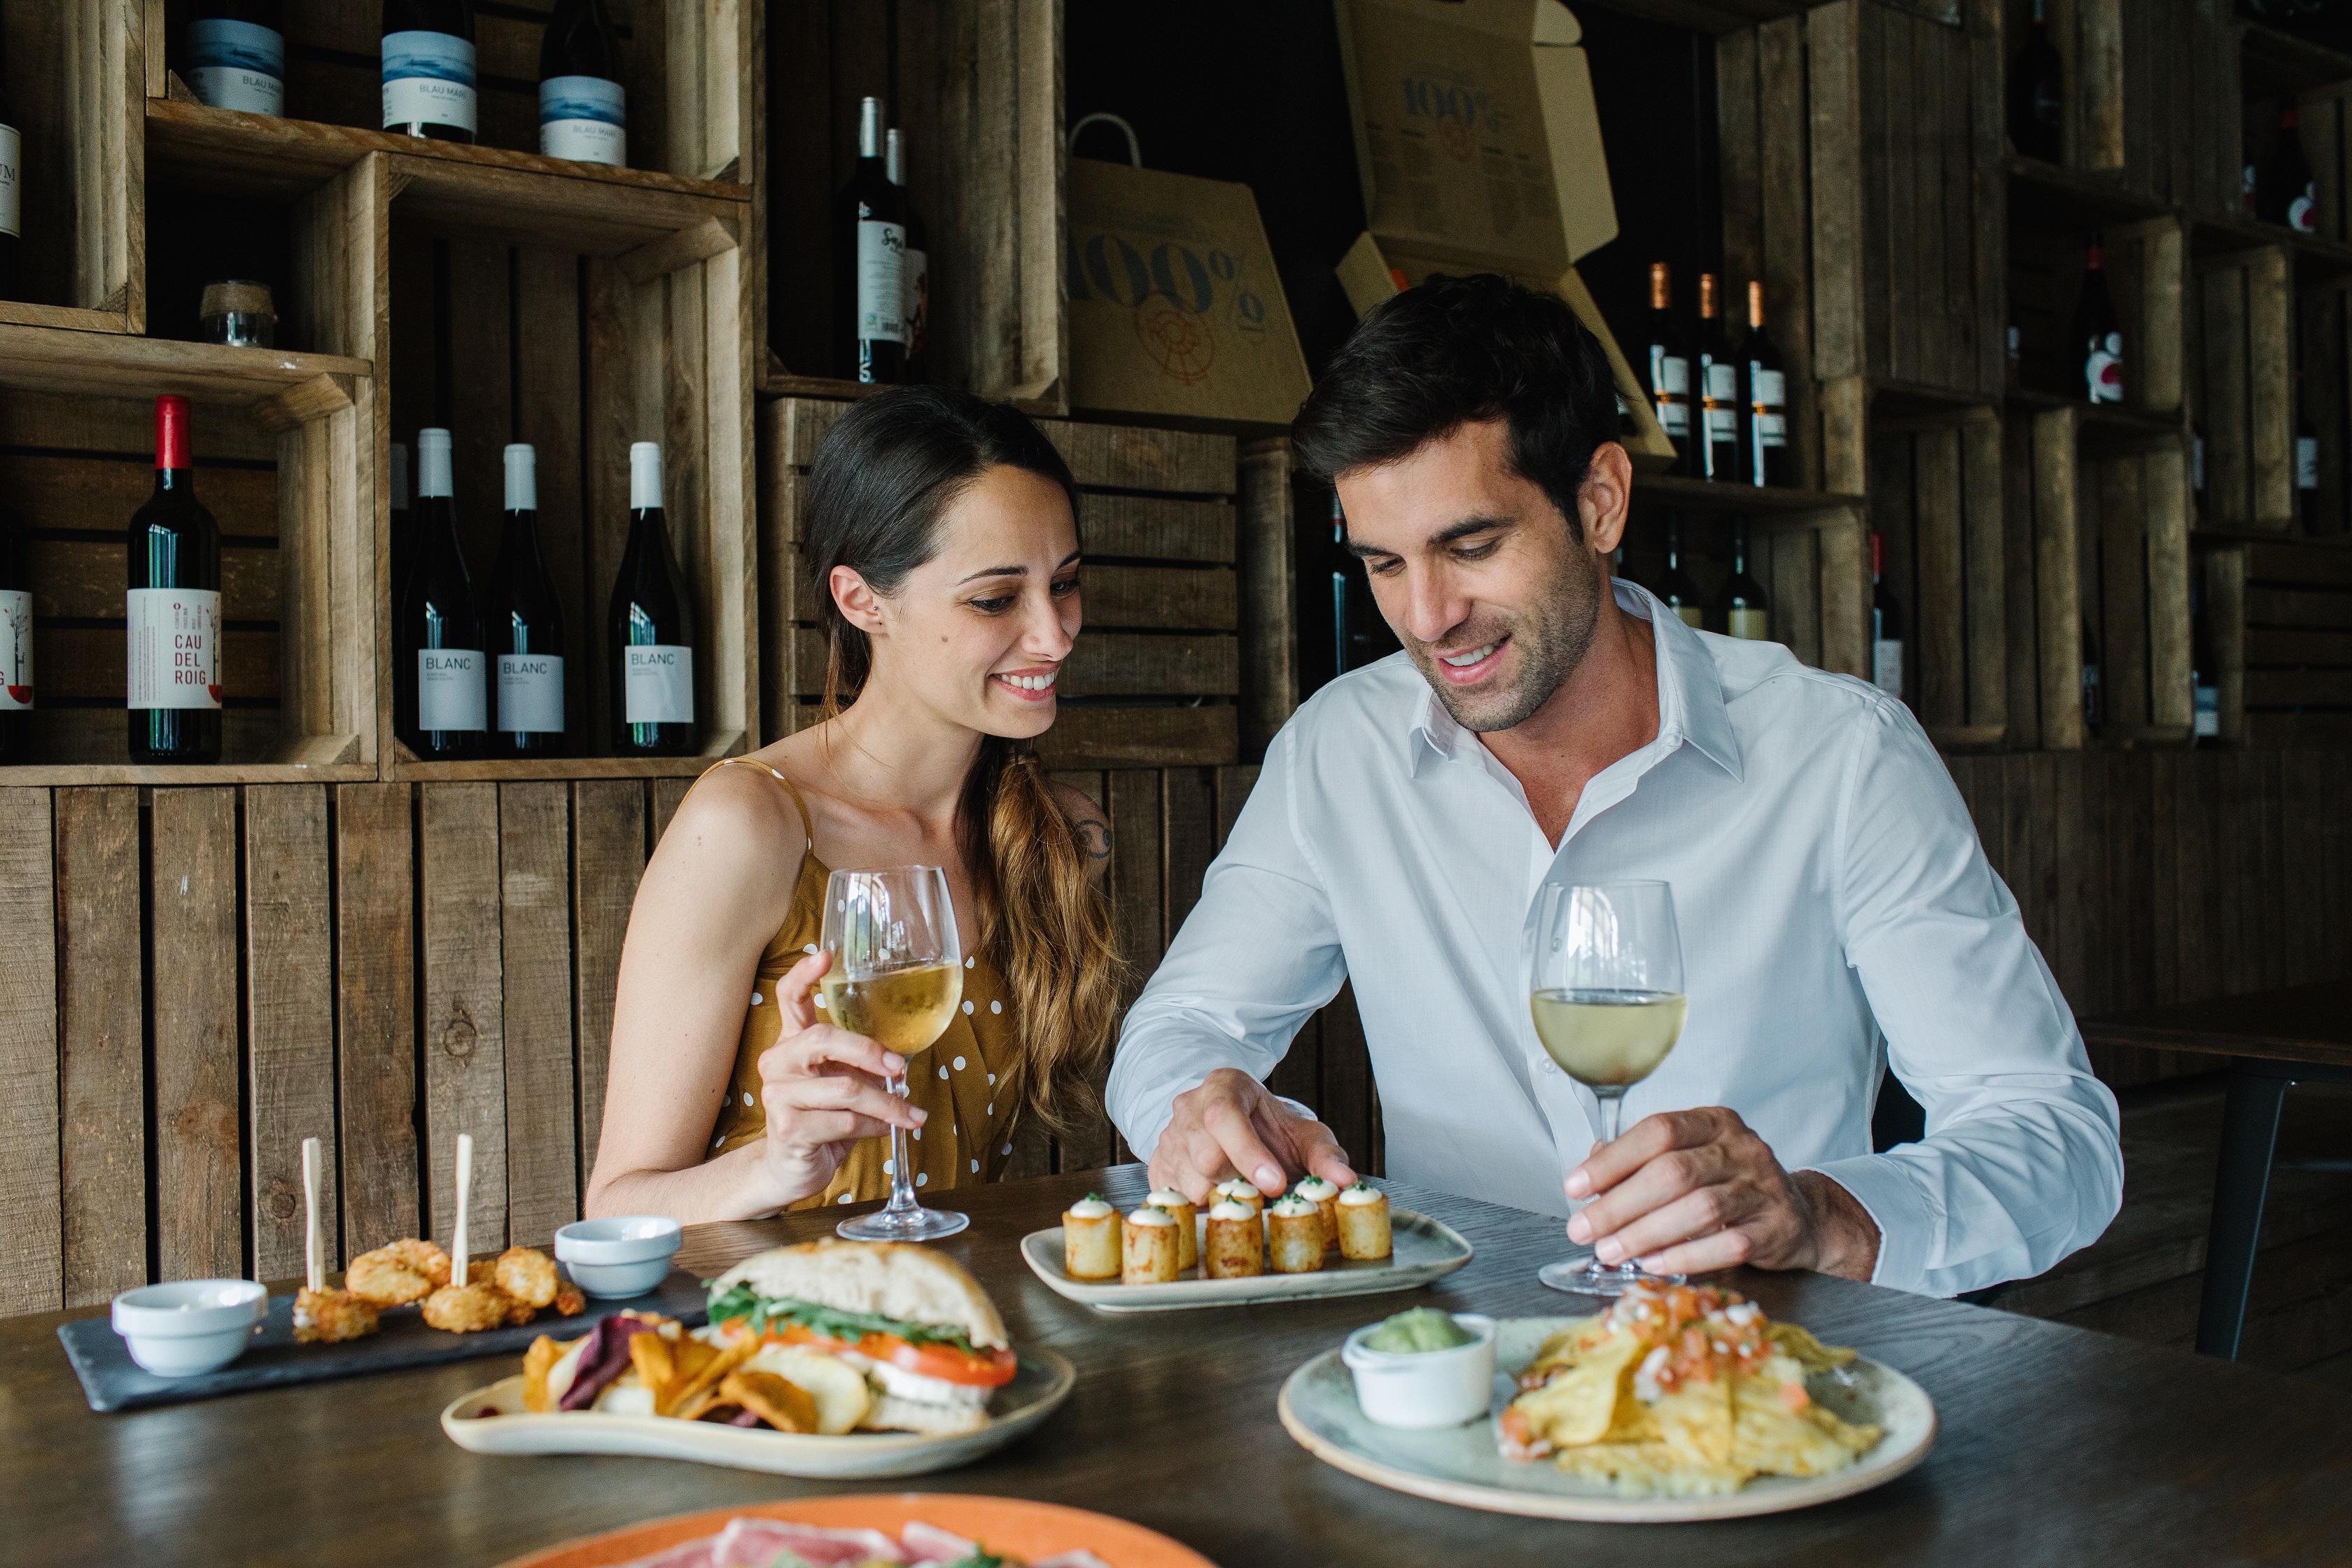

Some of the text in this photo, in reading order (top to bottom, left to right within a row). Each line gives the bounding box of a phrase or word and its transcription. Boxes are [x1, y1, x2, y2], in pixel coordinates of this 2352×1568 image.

[242, 75, 267, 89] BLAU
[419, 83, 444, 94] BLAU
[174, 634, 202, 650] CAU
[175, 652, 200, 667] DEL
[426, 657, 471, 670] BLANC
[631, 652, 675, 665] BLANC
[503, 662, 547, 675] BLANC
[175, 670, 206, 685] ROIG
